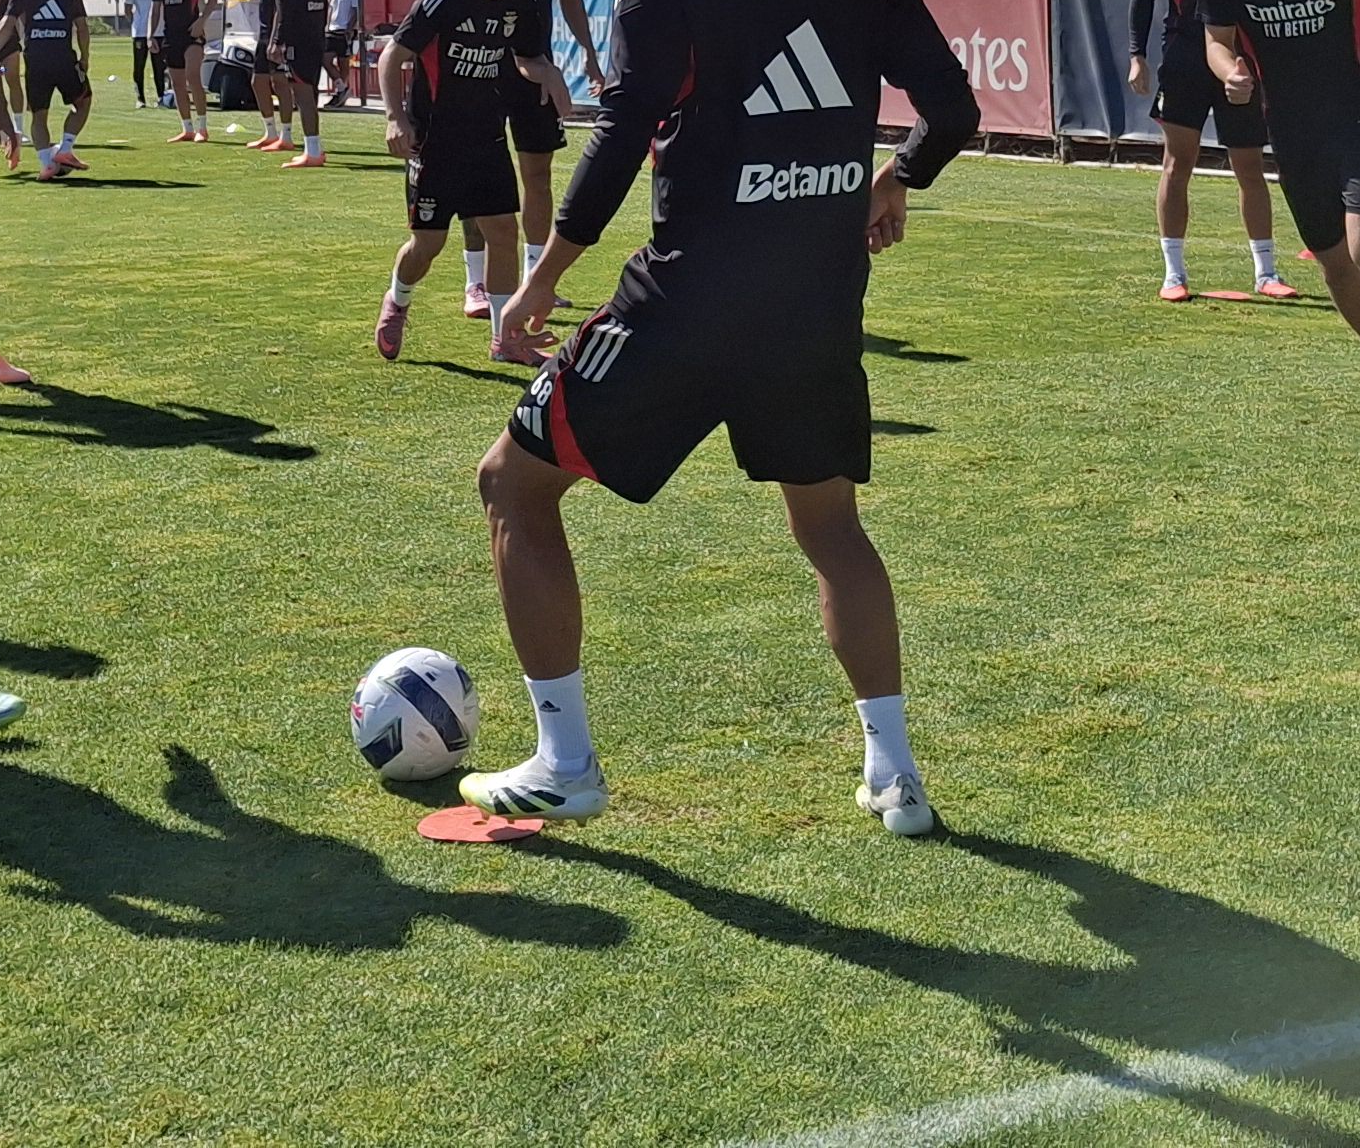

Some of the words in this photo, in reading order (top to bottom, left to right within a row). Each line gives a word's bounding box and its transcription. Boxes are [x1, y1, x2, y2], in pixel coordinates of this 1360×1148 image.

[485, 18, 499, 34] 77
[1263, 22, 1282, 39] FLY
[1284, 16, 1326, 38] BETTER
[735, 160, 865, 203] Betano
[530, 370, 554, 407] 68
